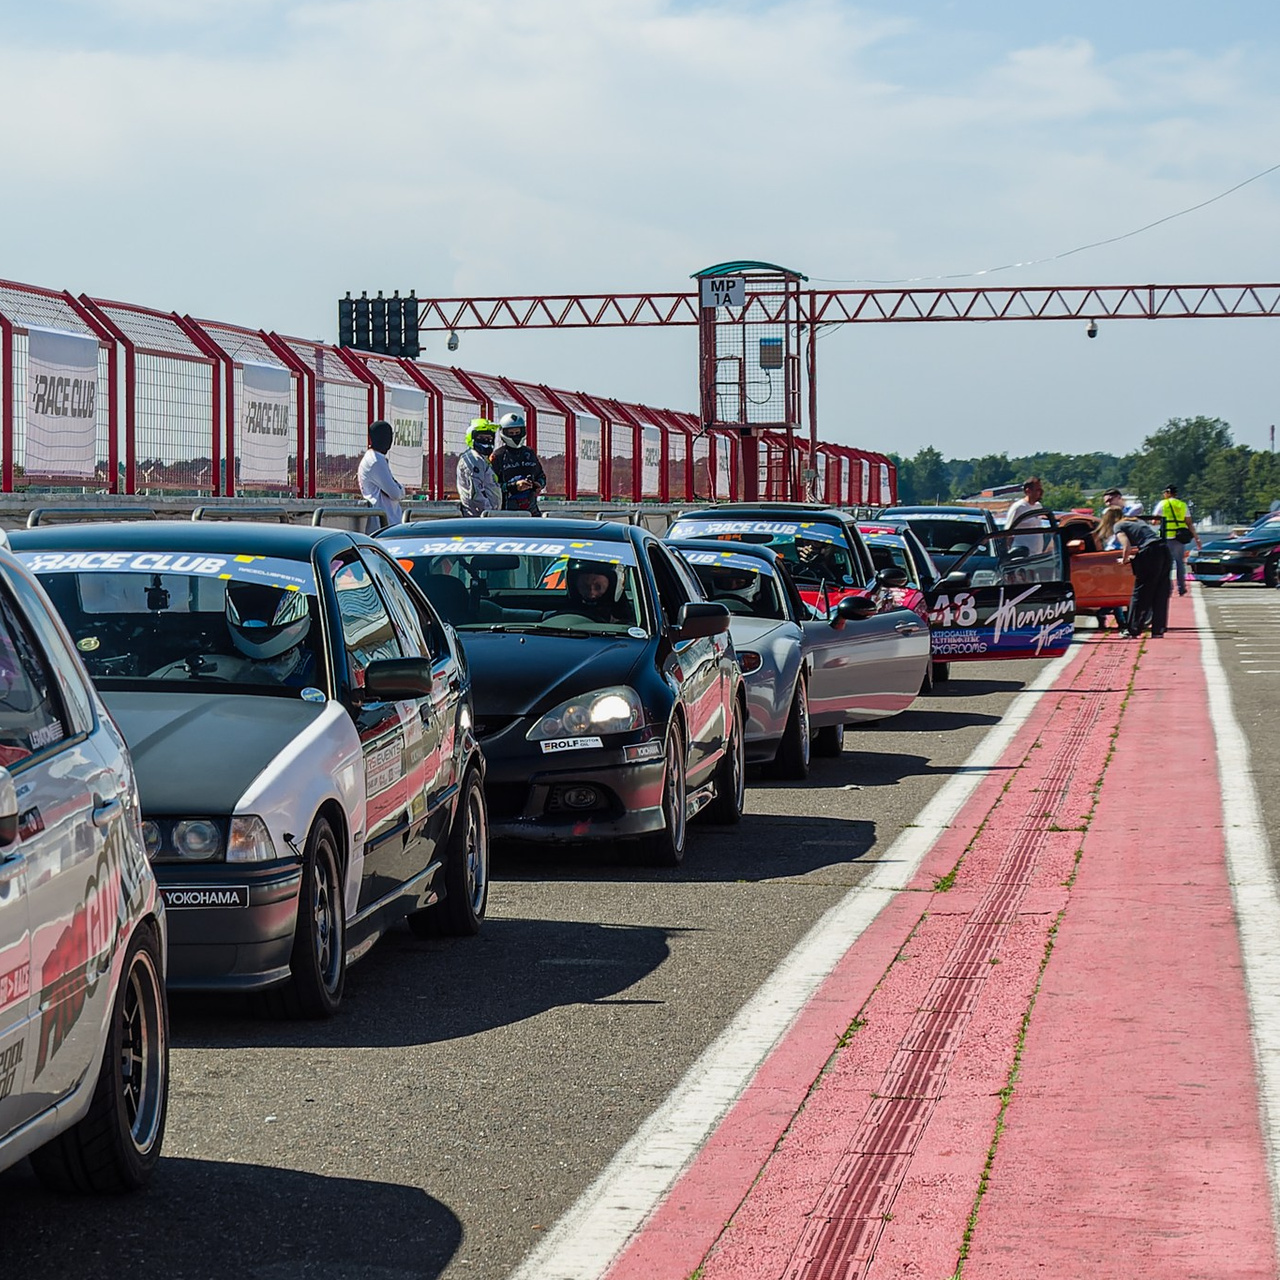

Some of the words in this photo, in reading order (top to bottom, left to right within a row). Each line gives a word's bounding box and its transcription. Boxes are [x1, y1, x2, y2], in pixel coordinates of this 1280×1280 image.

[714, 293, 732, 305] 1A
[33, 375, 70, 416] RACE
[71, 379, 95, 418] CLUB
[246, 401, 272, 434] RACE
[707, 523, 754, 533] RACE
[754, 523, 797, 534] CLUB
[421, 541, 494, 554] RACE
[495, 542, 565, 554] CLUB
[28, 553, 131, 570] RACE
[130, 555, 227, 573] CLUB
[683, 553, 717, 564] LUB
[551, 740, 579, 749] ROLF
[166, 891, 240, 904] YOKOHAMA
